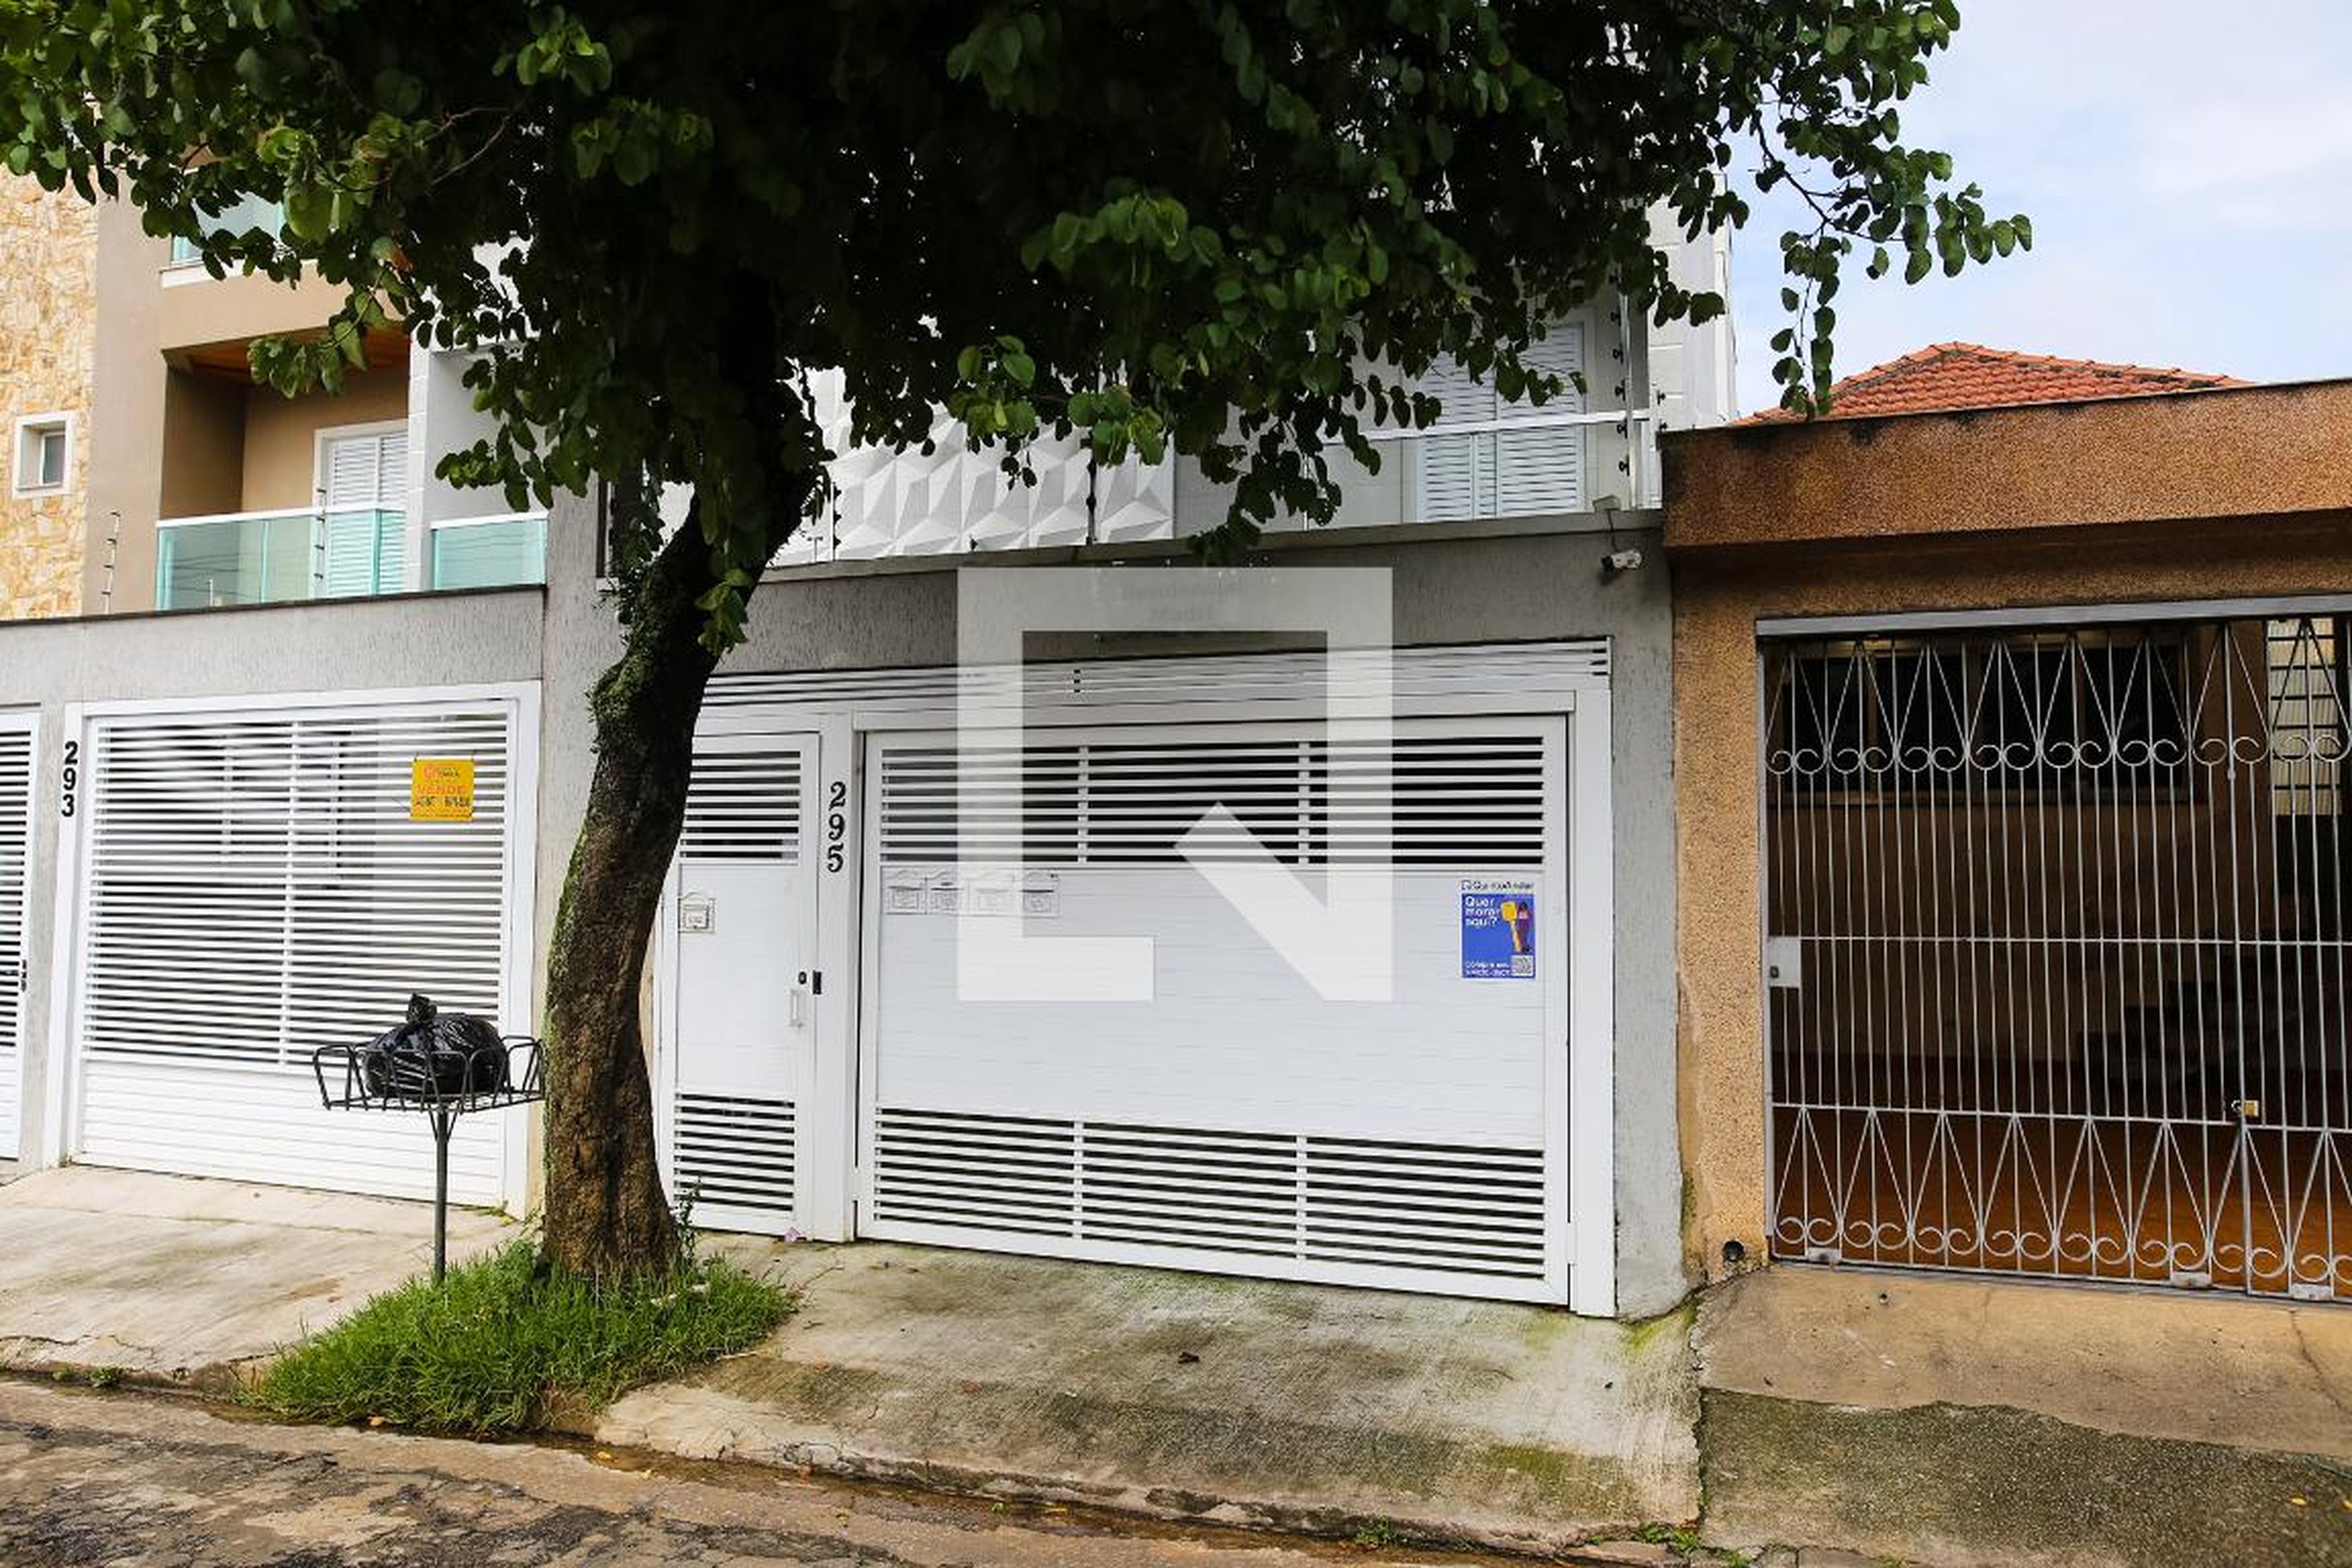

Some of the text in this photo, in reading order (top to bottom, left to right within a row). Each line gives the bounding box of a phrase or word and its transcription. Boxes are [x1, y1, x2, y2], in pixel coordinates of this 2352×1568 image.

[62, 741, 78, 817] 293
[827, 781, 846, 873] 295
[1465, 896, 1494, 907] Quer
